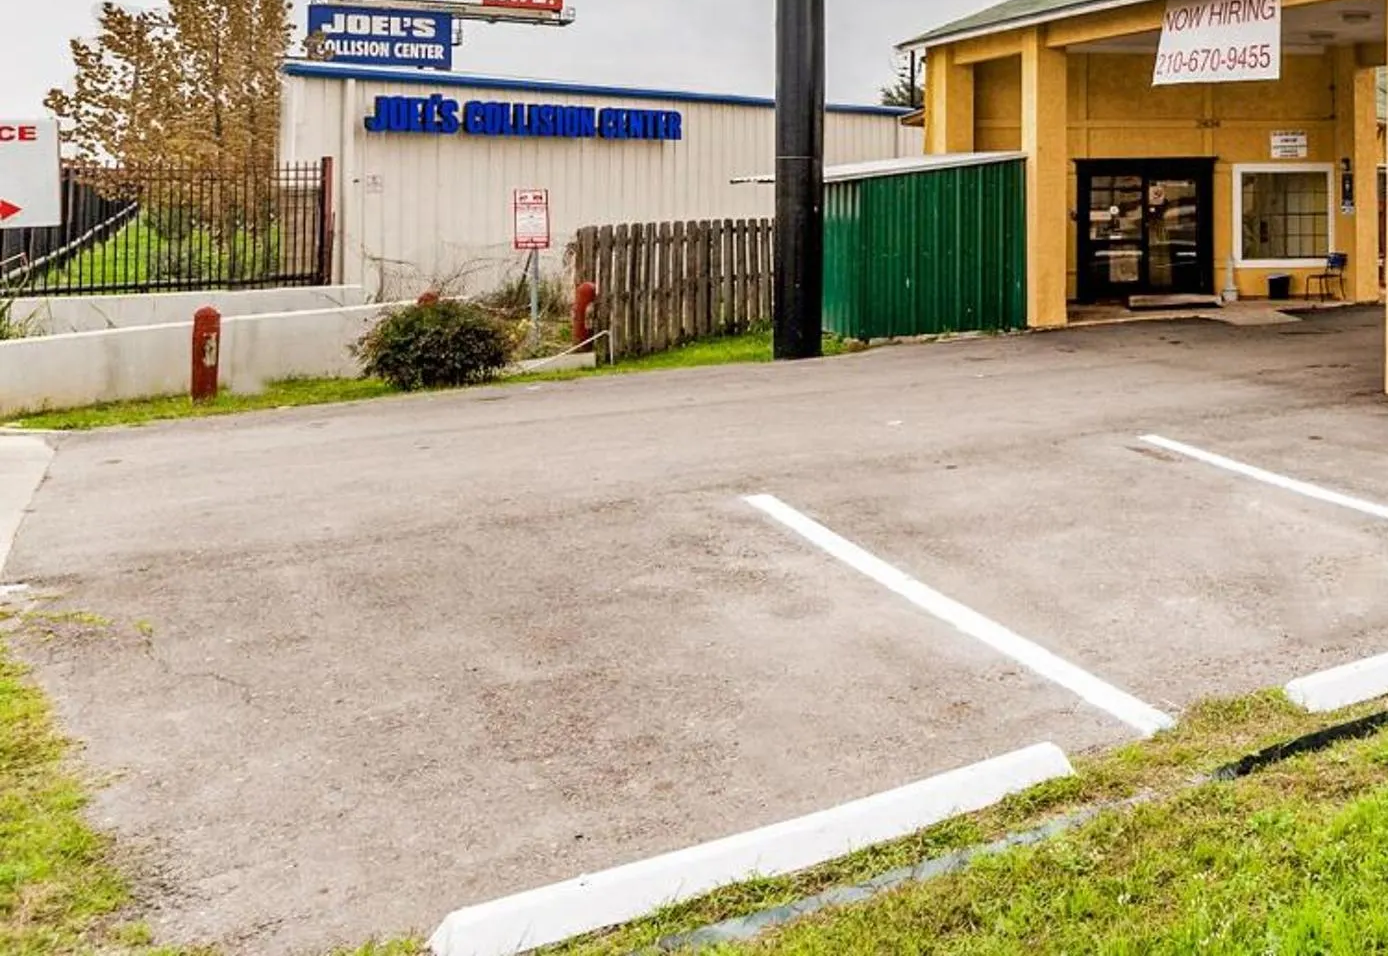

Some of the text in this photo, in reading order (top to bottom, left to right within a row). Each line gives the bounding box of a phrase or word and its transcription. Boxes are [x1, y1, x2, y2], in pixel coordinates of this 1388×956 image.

[321, 13, 436, 38] JOEL'S
[1165, 5, 1205, 32] NOW
[393, 43, 445, 60] CENTER
[1157, 44, 1271, 75] 210-670-9455
[364, 94, 682, 140] JOEL'S COLLISION CENTER
